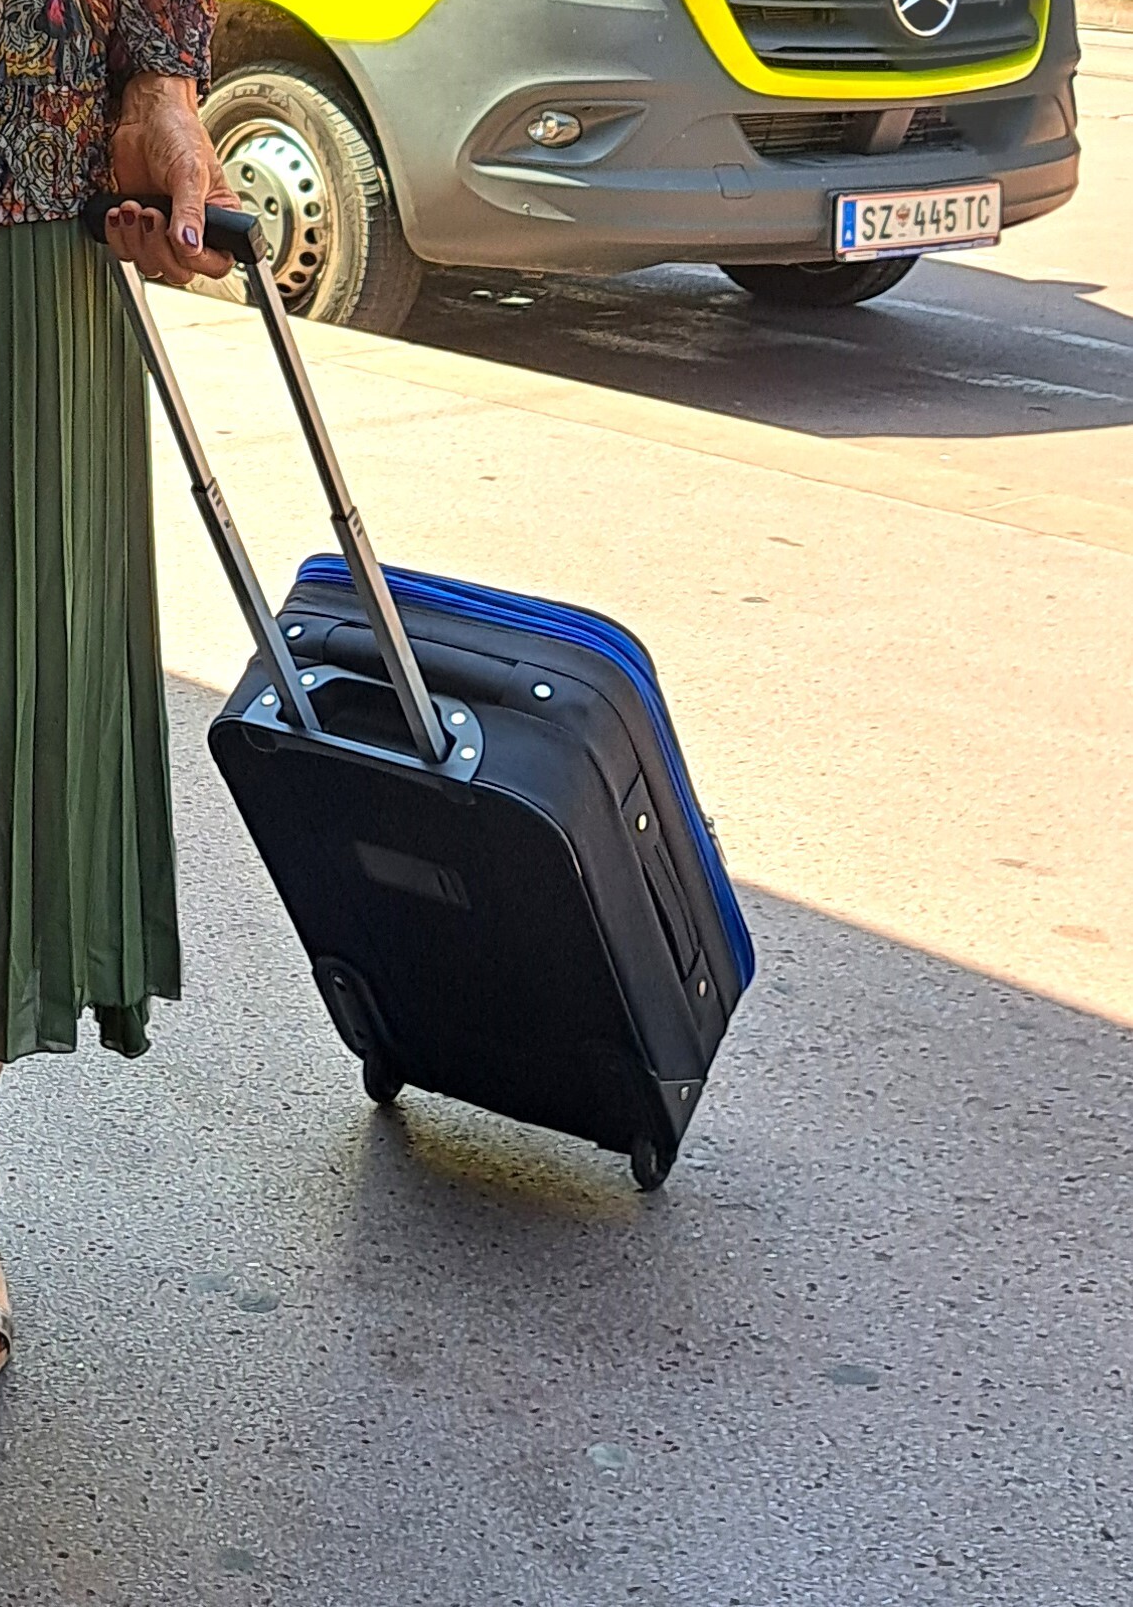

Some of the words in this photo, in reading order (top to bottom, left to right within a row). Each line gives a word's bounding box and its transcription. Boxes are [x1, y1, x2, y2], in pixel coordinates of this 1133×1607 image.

[861, 204, 894, 241] SZ
[913, 197, 958, 237] 445
[964, 193, 991, 230] TC
